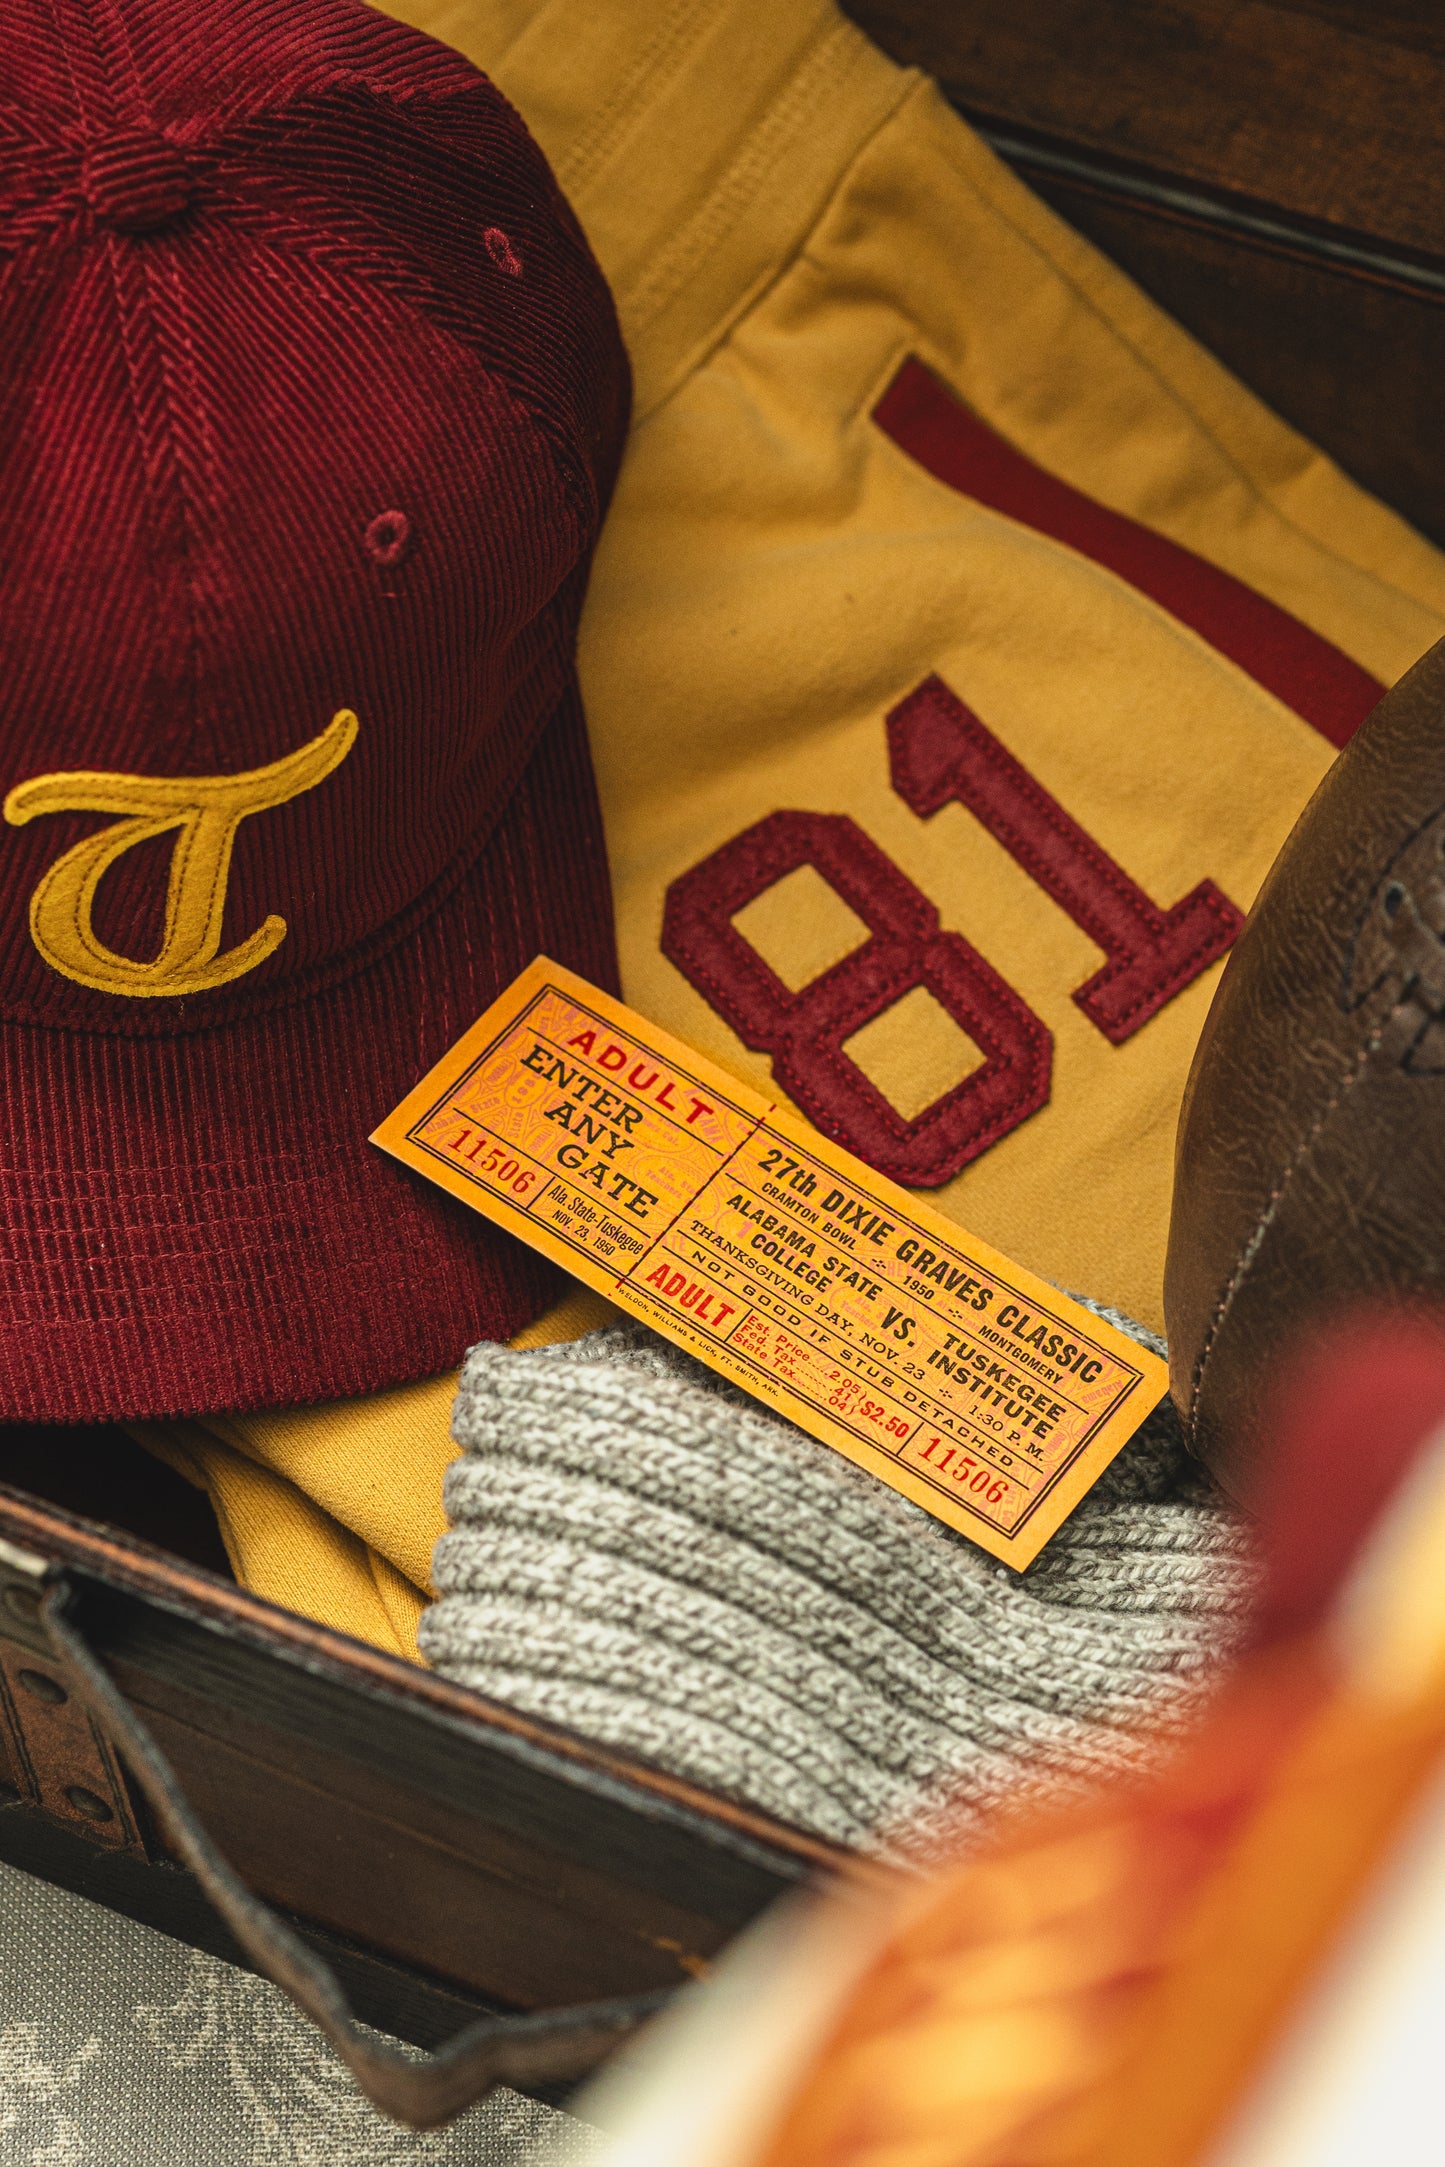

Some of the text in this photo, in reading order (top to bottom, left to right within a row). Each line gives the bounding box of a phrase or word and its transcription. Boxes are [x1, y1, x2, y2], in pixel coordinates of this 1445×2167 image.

[660, 672, 1247, 1190] 81
[520, 1043, 643, 1134] ENTER
[567, 1030, 714, 1124] ADULT
[448, 1130, 536, 1193] 11506
[544, 1101, 635, 1159] ANY
[547, 1185, 648, 1254] Ala. State-Tuskegee
[557, 1144, 659, 1218] GATE
[549, 1209, 616, 1256] NOV. 23, 1950
[726, 1195, 816, 1258] ALABAMA
[823, 1256, 883, 1301] STATE
[751, 1234, 832, 1293] COLLEGE
[758, 1149, 817, 1197] 27th
[820, 1189, 896, 1246] DIXIE
[896, 1239, 993, 1311] GRAVES
[997, 1305, 1103, 1383] CLASSIC
[645, 1264, 735, 1327] ADULT
[762, 1183, 819, 1224] CRAMTON
[821, 1222, 856, 1250] BOWL
[903, 1273, 934, 1300] 1950
[978, 1325, 1064, 1384] MONTGOMERY
[881, 1306, 916, 1347] VS.
[619, 1288, 649, 1312] WELDON,
[653, 1311, 687, 1336] WILLIAMS
[698, 1341, 717, 1357] LICK,
[720, 1356, 732, 1366] FT.
[735, 1365, 759, 1385] SMITH,
[762, 1384, 778, 1397] ARK.
[690, 1220, 814, 1305] THANKSGIVING
[814, 1303, 854, 1336] DAY,
[859, 1332, 899, 1365] NOV.
[902, 1362, 925, 1380] 23
[969, 1405, 1003, 1431] 1:30
[1006, 1430, 1021, 1446] P.
[1024, 1442, 1044, 1461] M.
[692, 1251, 1013, 1466] NOT GOOD IF STUB DETACHED
[943, 1333, 1067, 1423] TUSKEGEE
[859, 1401, 909, 1438] $2.50
[927, 1350, 1053, 1439] INSTITUTE
[918, 1438, 1009, 1503] 11506
